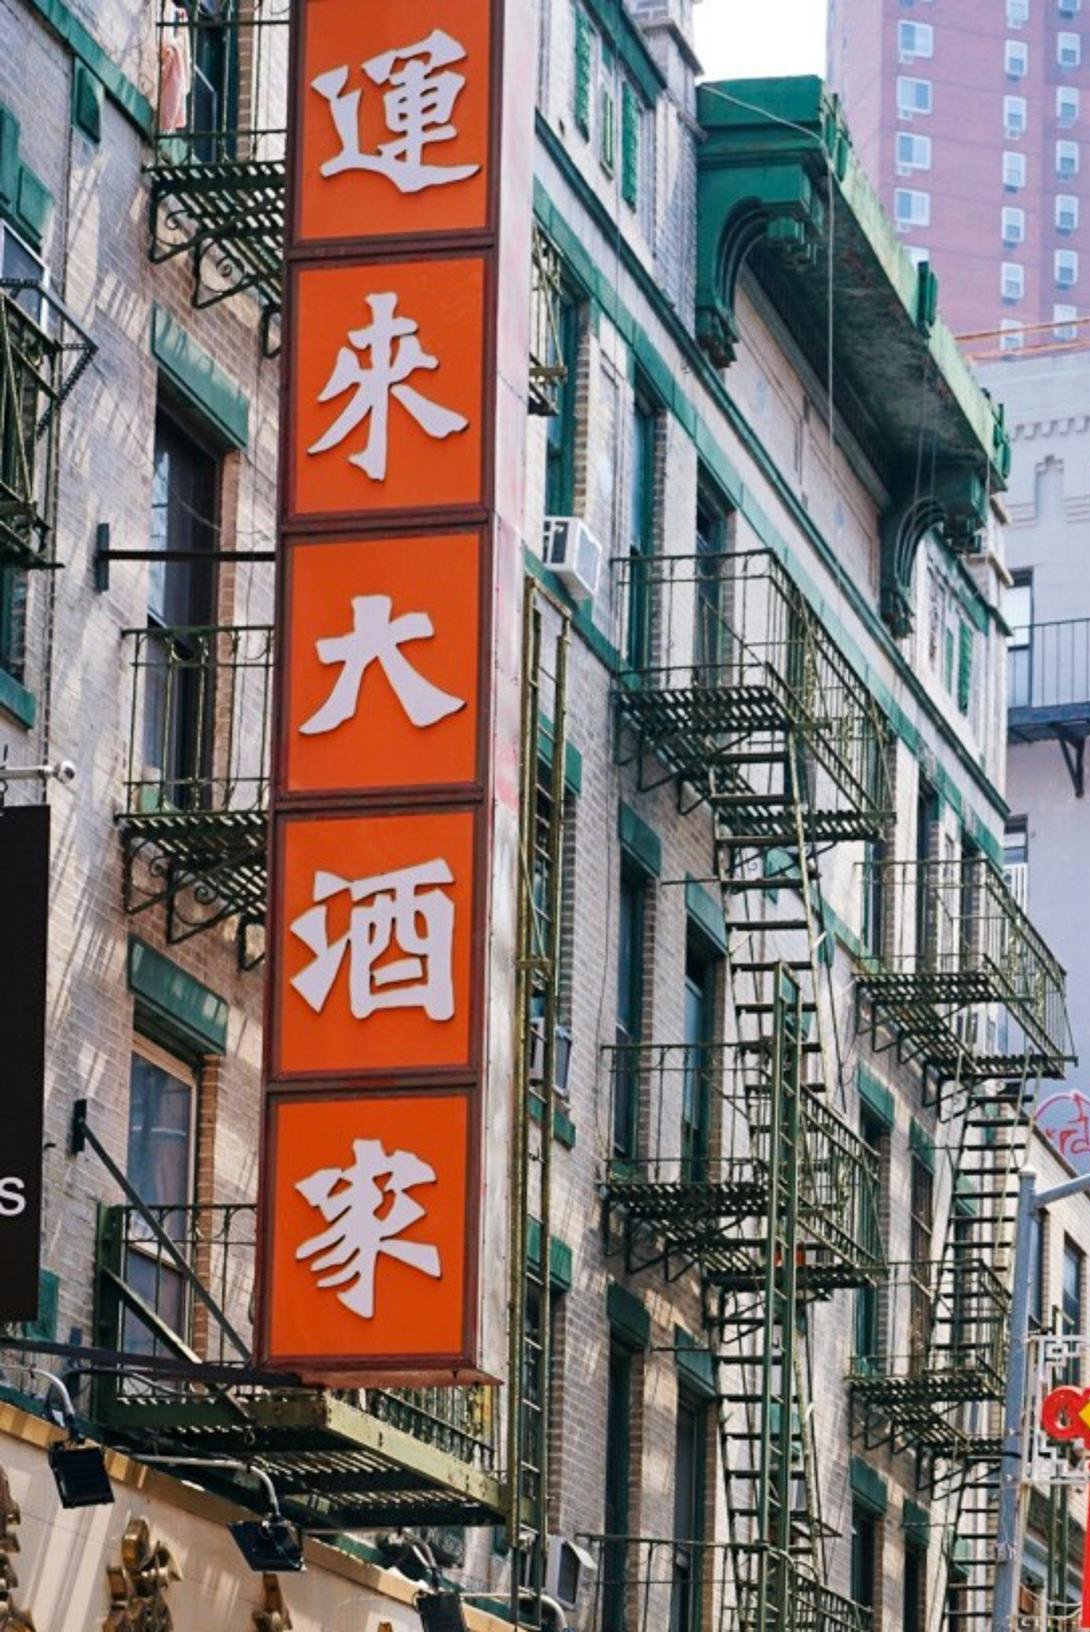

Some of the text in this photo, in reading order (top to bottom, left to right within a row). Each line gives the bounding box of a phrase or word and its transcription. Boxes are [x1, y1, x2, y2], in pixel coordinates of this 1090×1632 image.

[290, 28, 482, 1320] 運來大酒家
